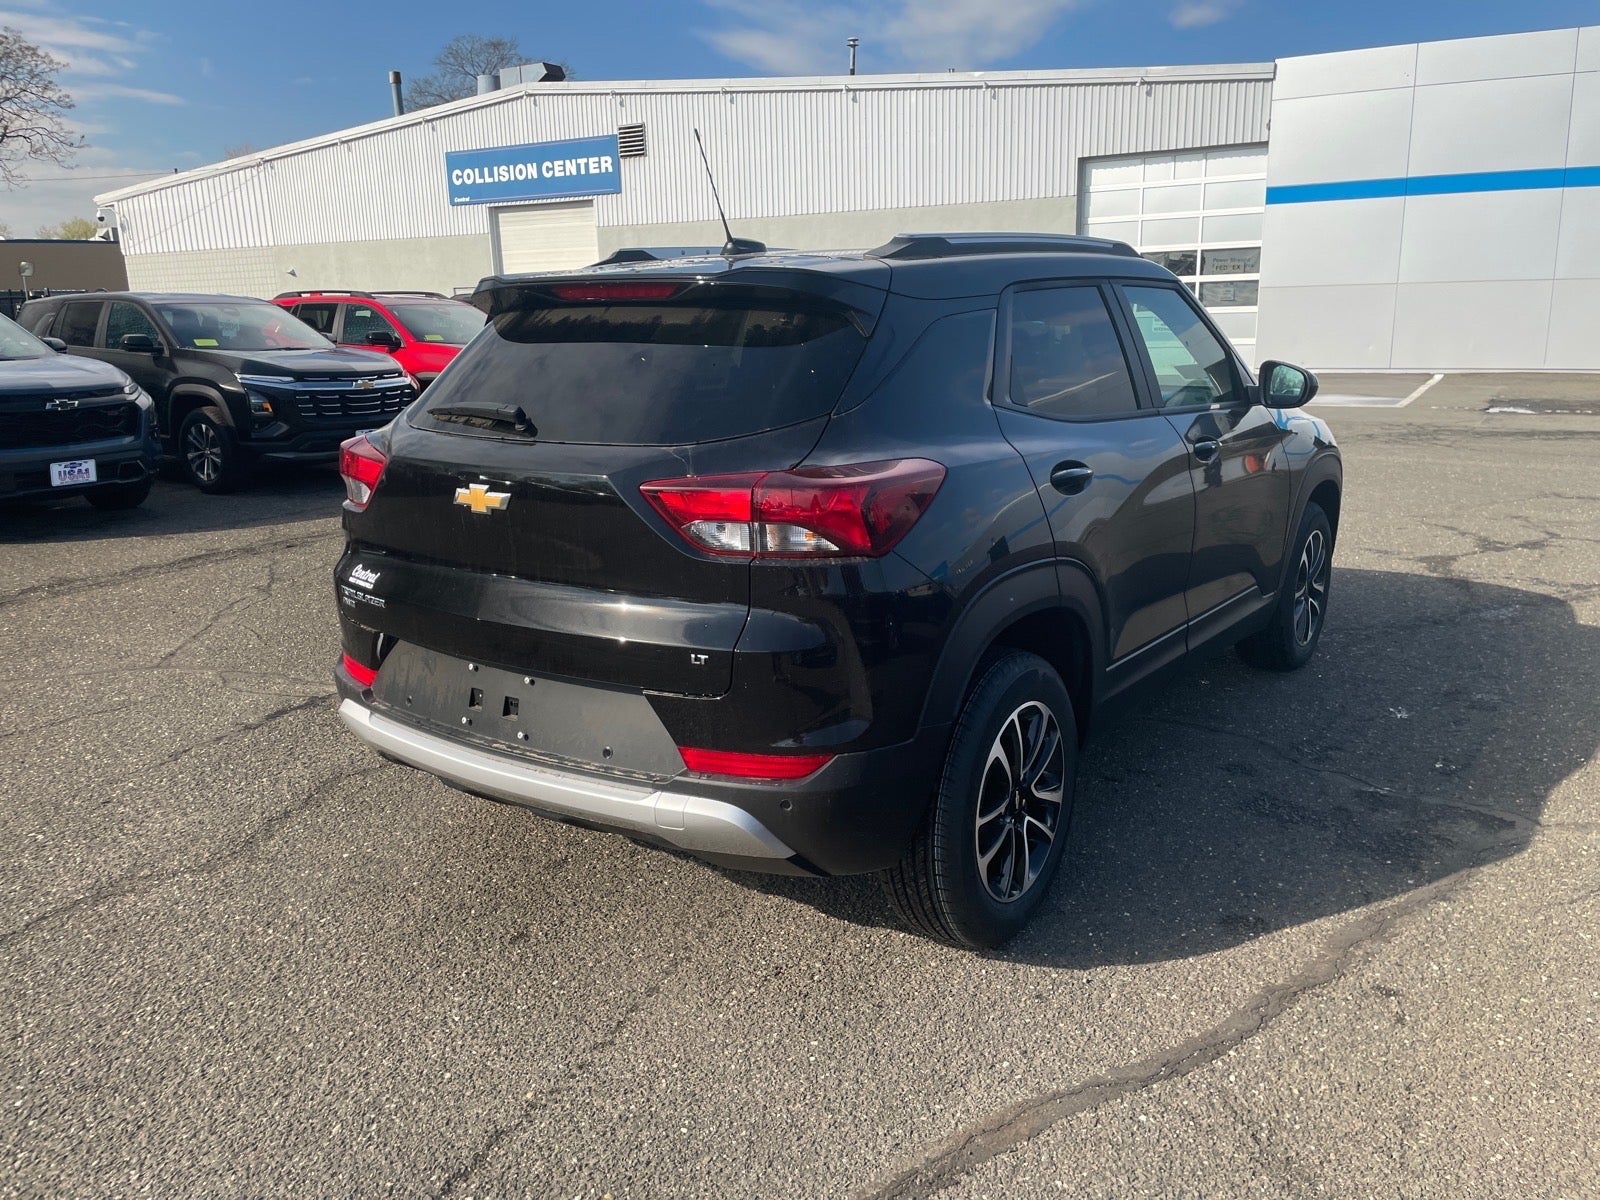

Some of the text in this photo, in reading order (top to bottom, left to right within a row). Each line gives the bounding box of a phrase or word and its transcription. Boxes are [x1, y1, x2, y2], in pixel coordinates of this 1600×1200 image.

[452, 155, 613, 186] COLLISION CENTER
[352, 564, 380, 583] Central
[690, 653, 709, 665] LT
